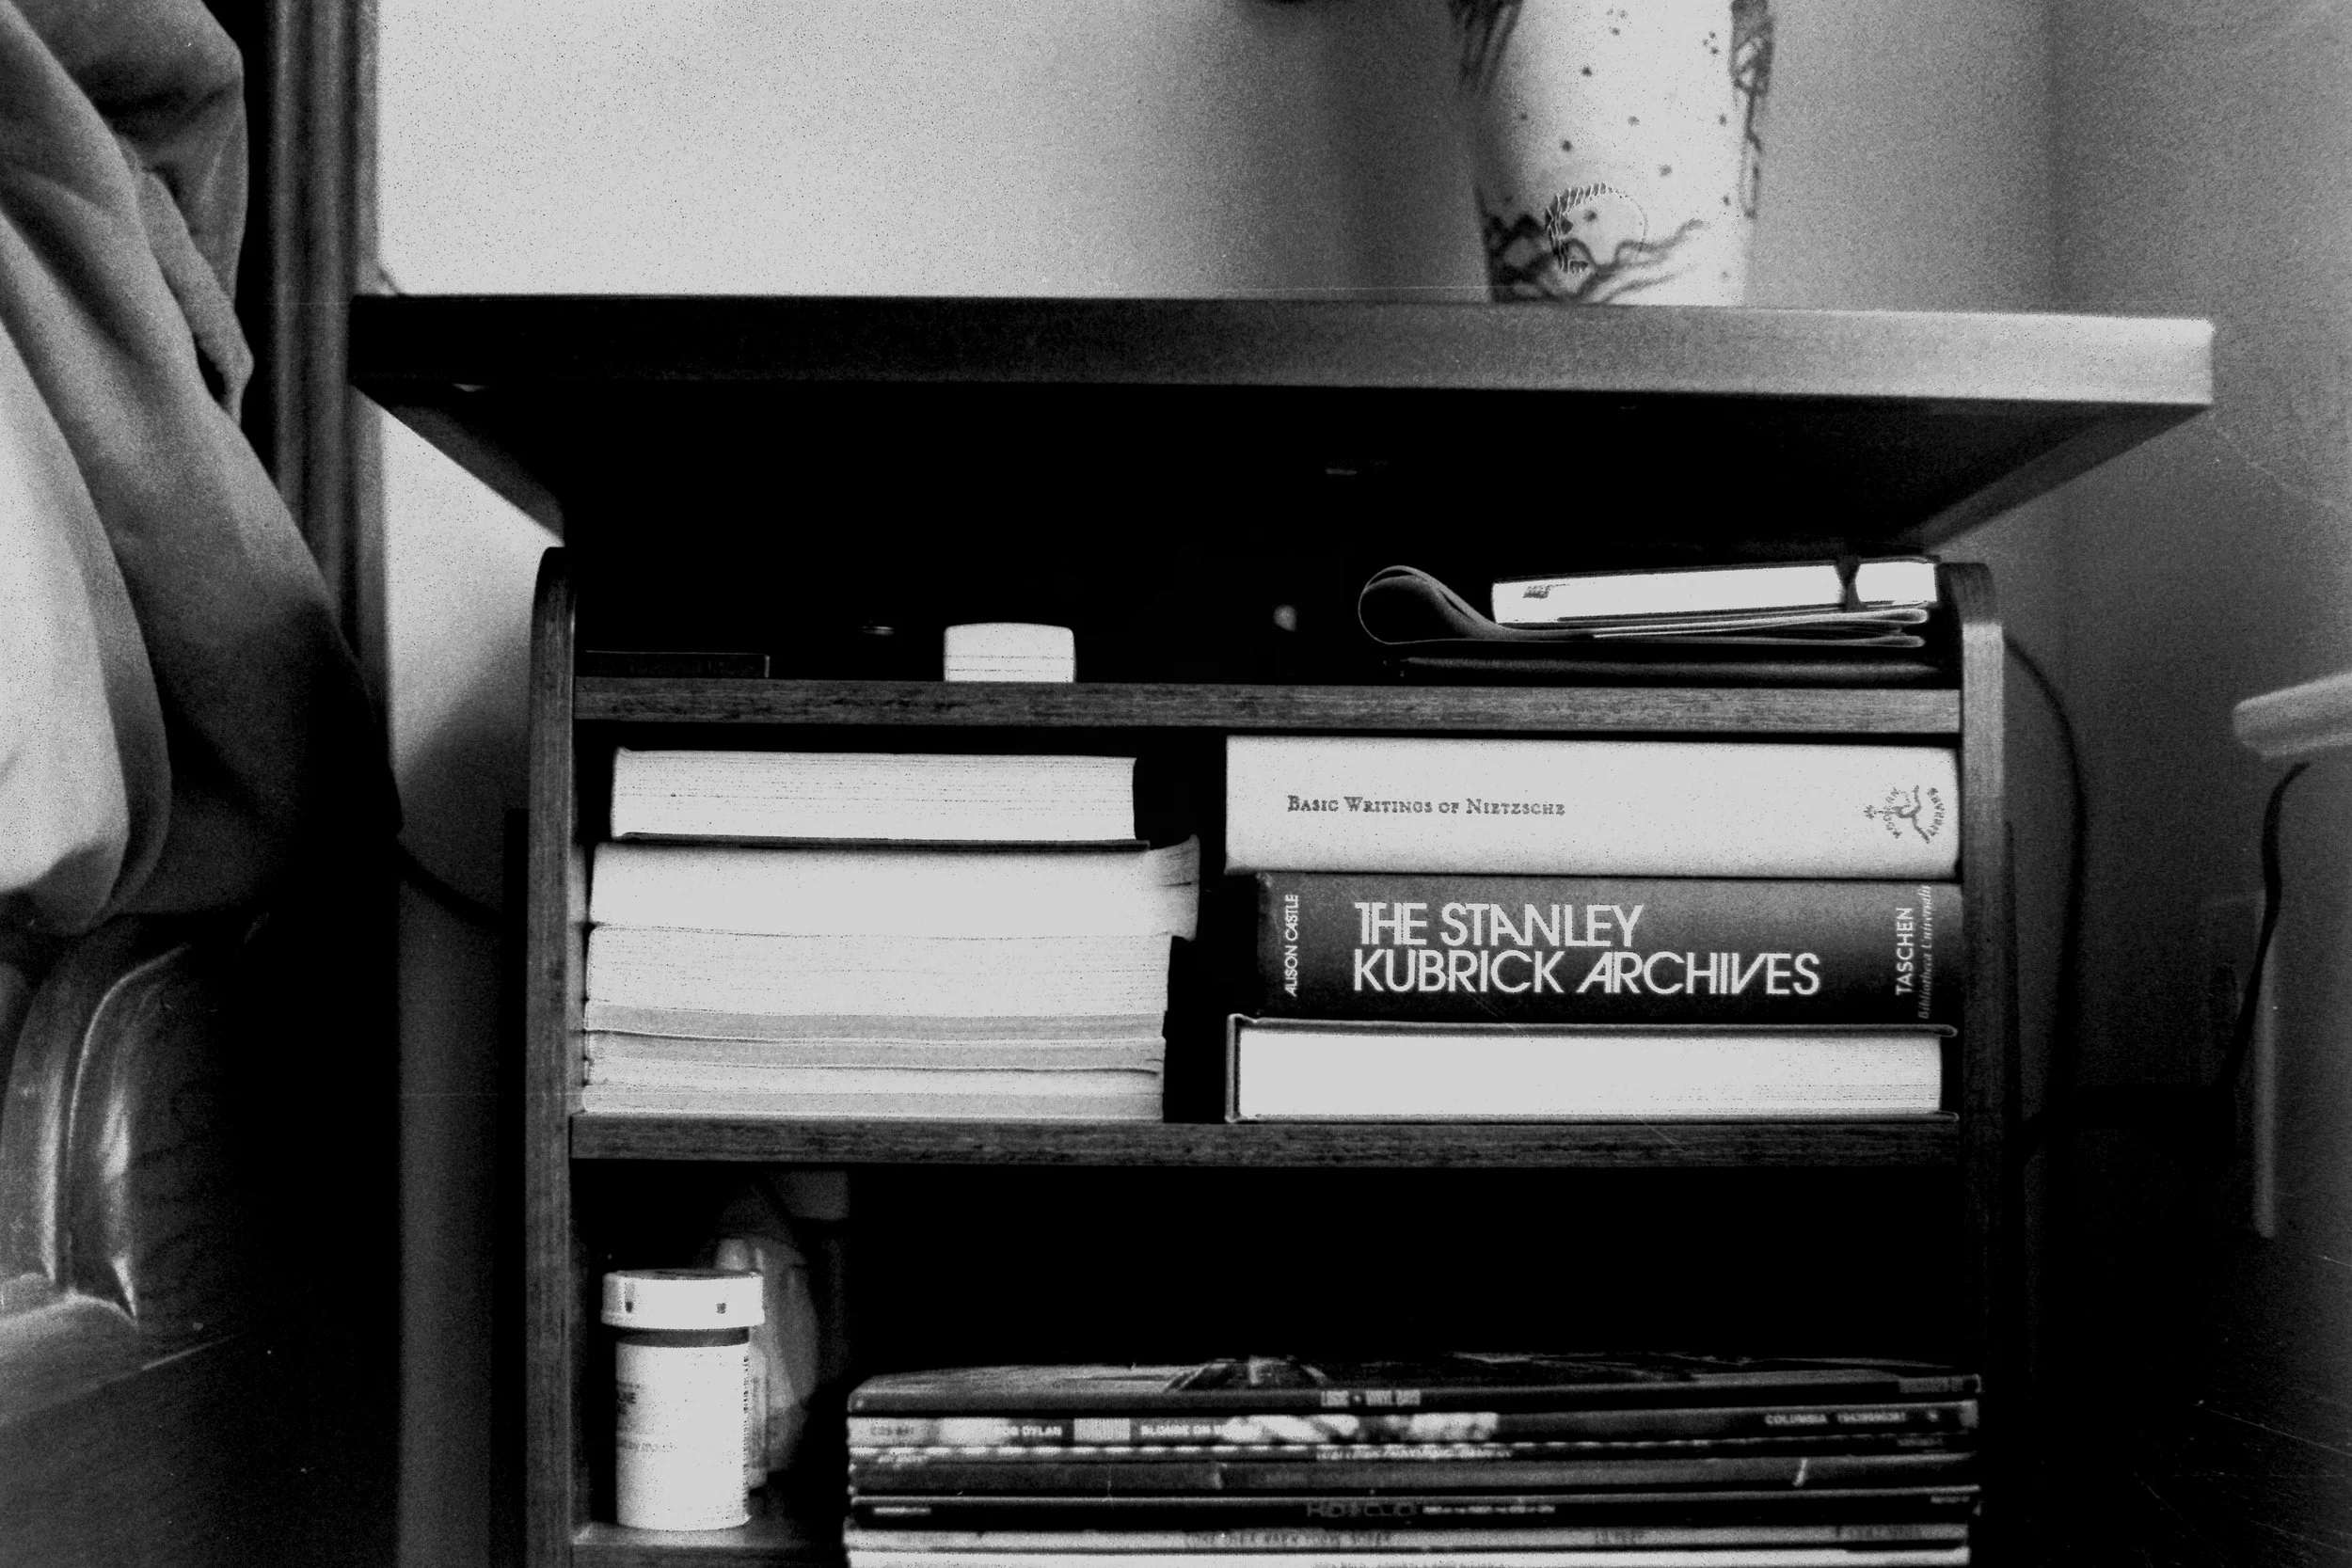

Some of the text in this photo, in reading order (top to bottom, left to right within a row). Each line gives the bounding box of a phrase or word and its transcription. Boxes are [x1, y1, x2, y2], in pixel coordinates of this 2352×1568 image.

[1283, 894, 1299, 998] ALISON CASTLE
[1354, 901, 1645, 948] THE STANLEY
[1895, 907, 1915, 996] TASCHEN
[1354, 948, 1821, 996] KUBRICK ARCHIVES
